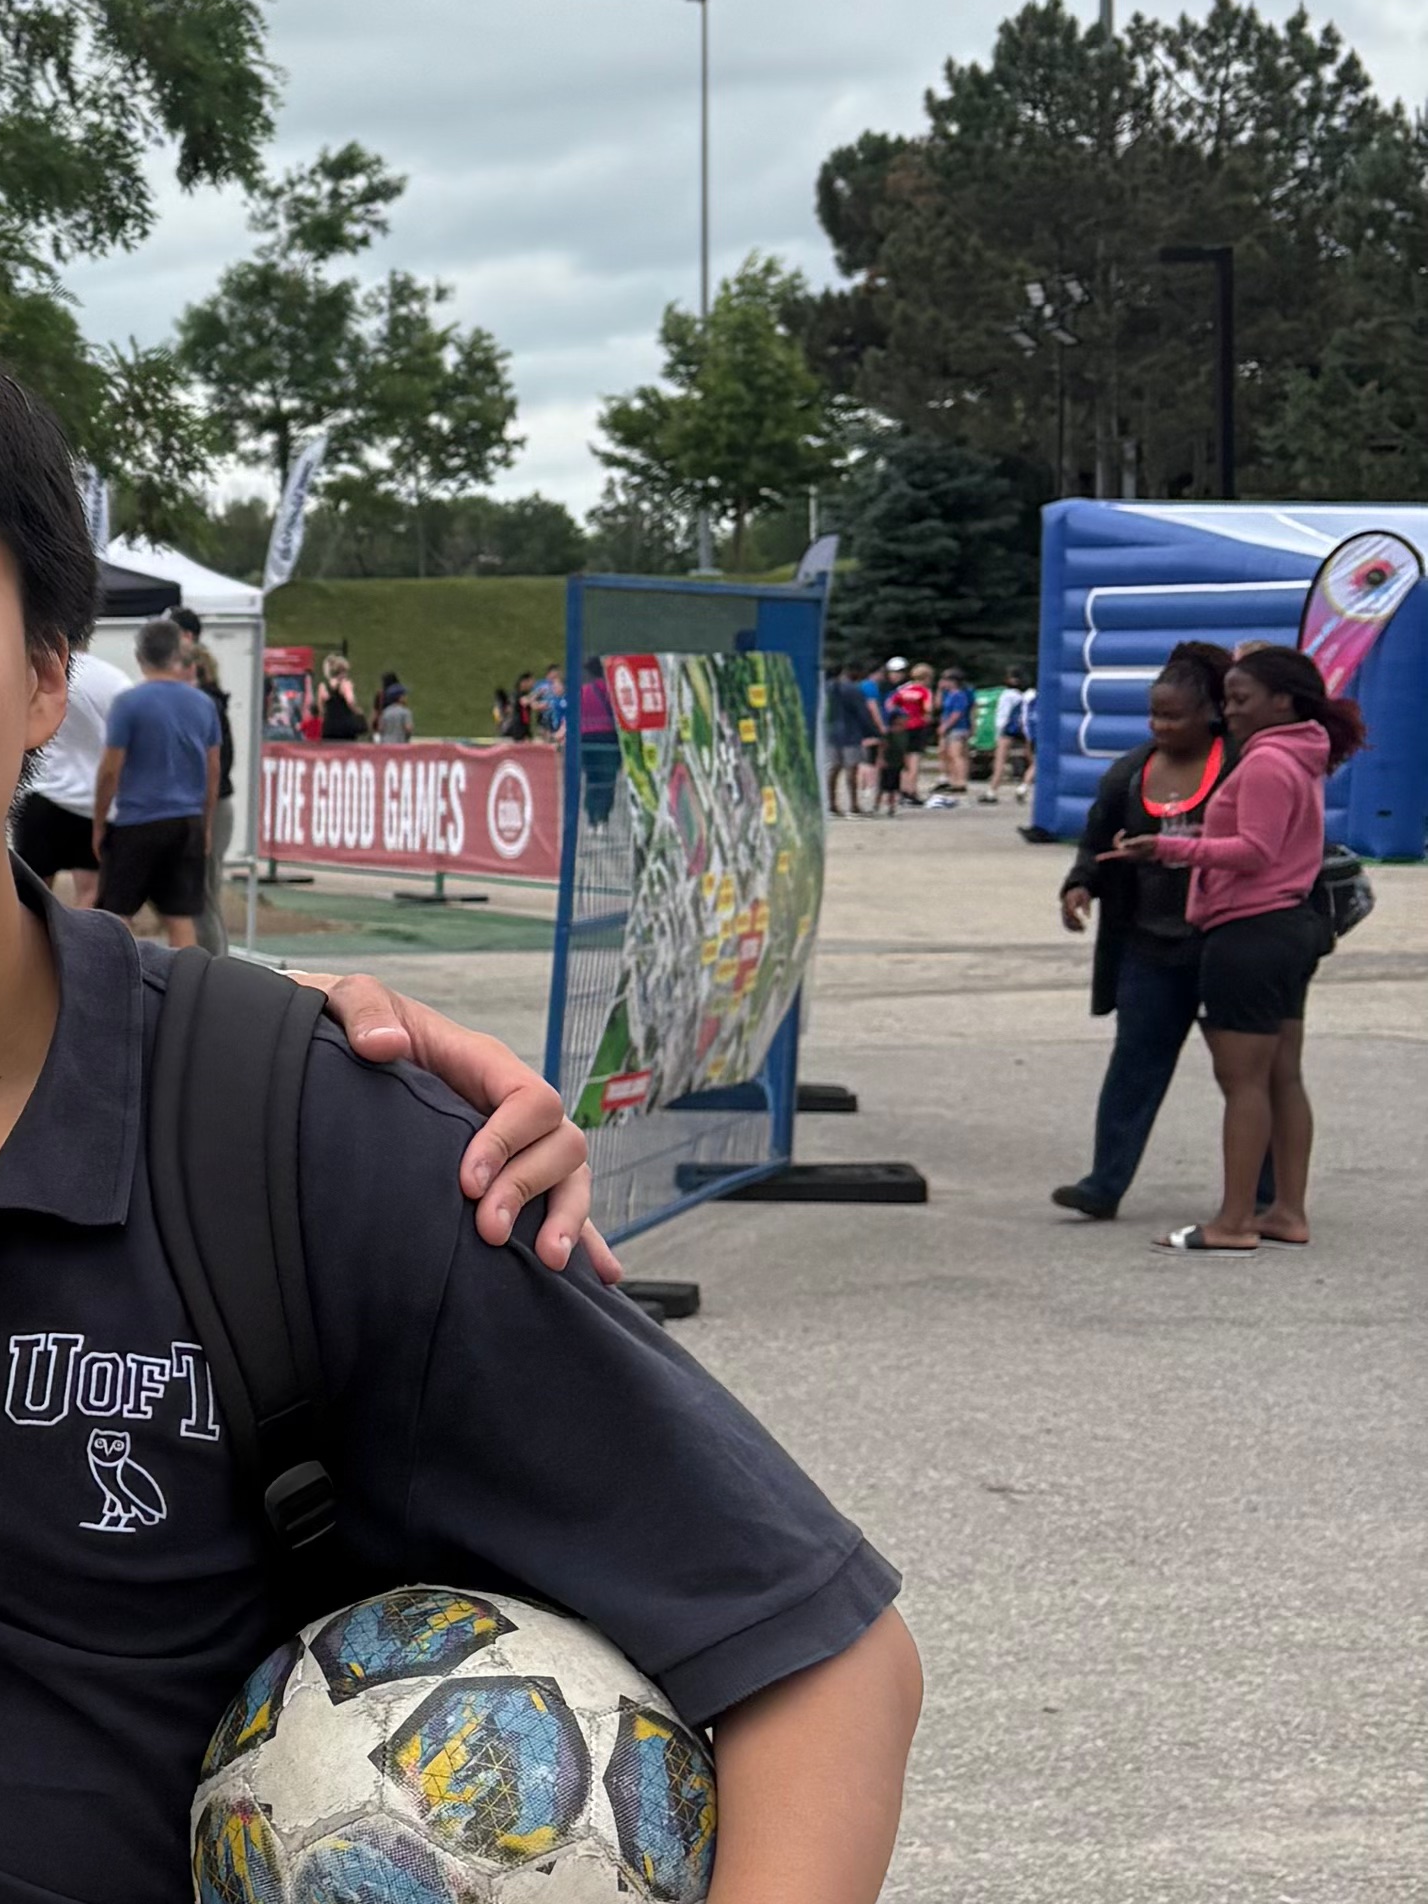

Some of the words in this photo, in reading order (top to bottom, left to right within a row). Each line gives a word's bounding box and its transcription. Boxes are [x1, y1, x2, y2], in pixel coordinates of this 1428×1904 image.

[263, 757, 307, 845] THE
[312, 758, 376, 850] GOOD
[383, 759, 466, 856] GAMES
